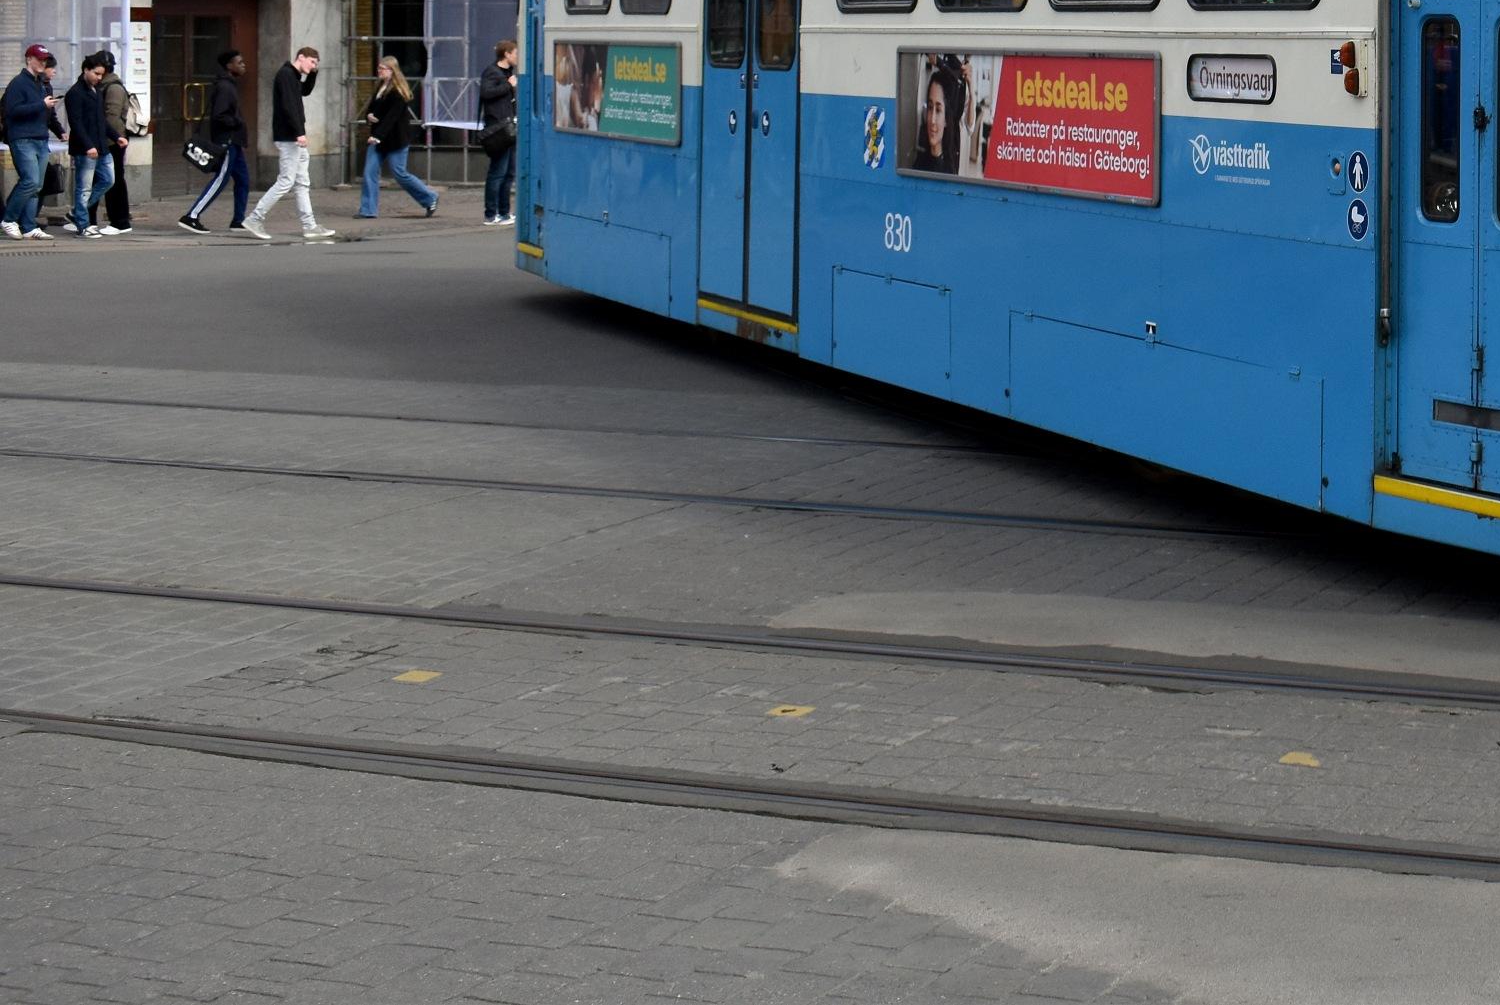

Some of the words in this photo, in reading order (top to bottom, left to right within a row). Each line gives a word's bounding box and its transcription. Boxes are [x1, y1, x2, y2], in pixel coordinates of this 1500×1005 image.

[613, 55, 667, 84] letsdeal.se
[1016, 70, 1129, 113] letsdeal.se
[1005, 117, 1050, 139] Rabatter
[1051, 119, 1066, 144] på
[1067, 123, 1140, 151] restauranger,
[996, 141, 1036, 162] skönhet
[1036, 143, 1057, 165] och
[1058, 145, 1087, 169] hälsa
[1088, 148, 1093, 169] i
[1093, 149, 1150, 180] Göteborg!
[1212, 140, 1271, 170] västtrafik
[885, 212, 912, 253] 830
